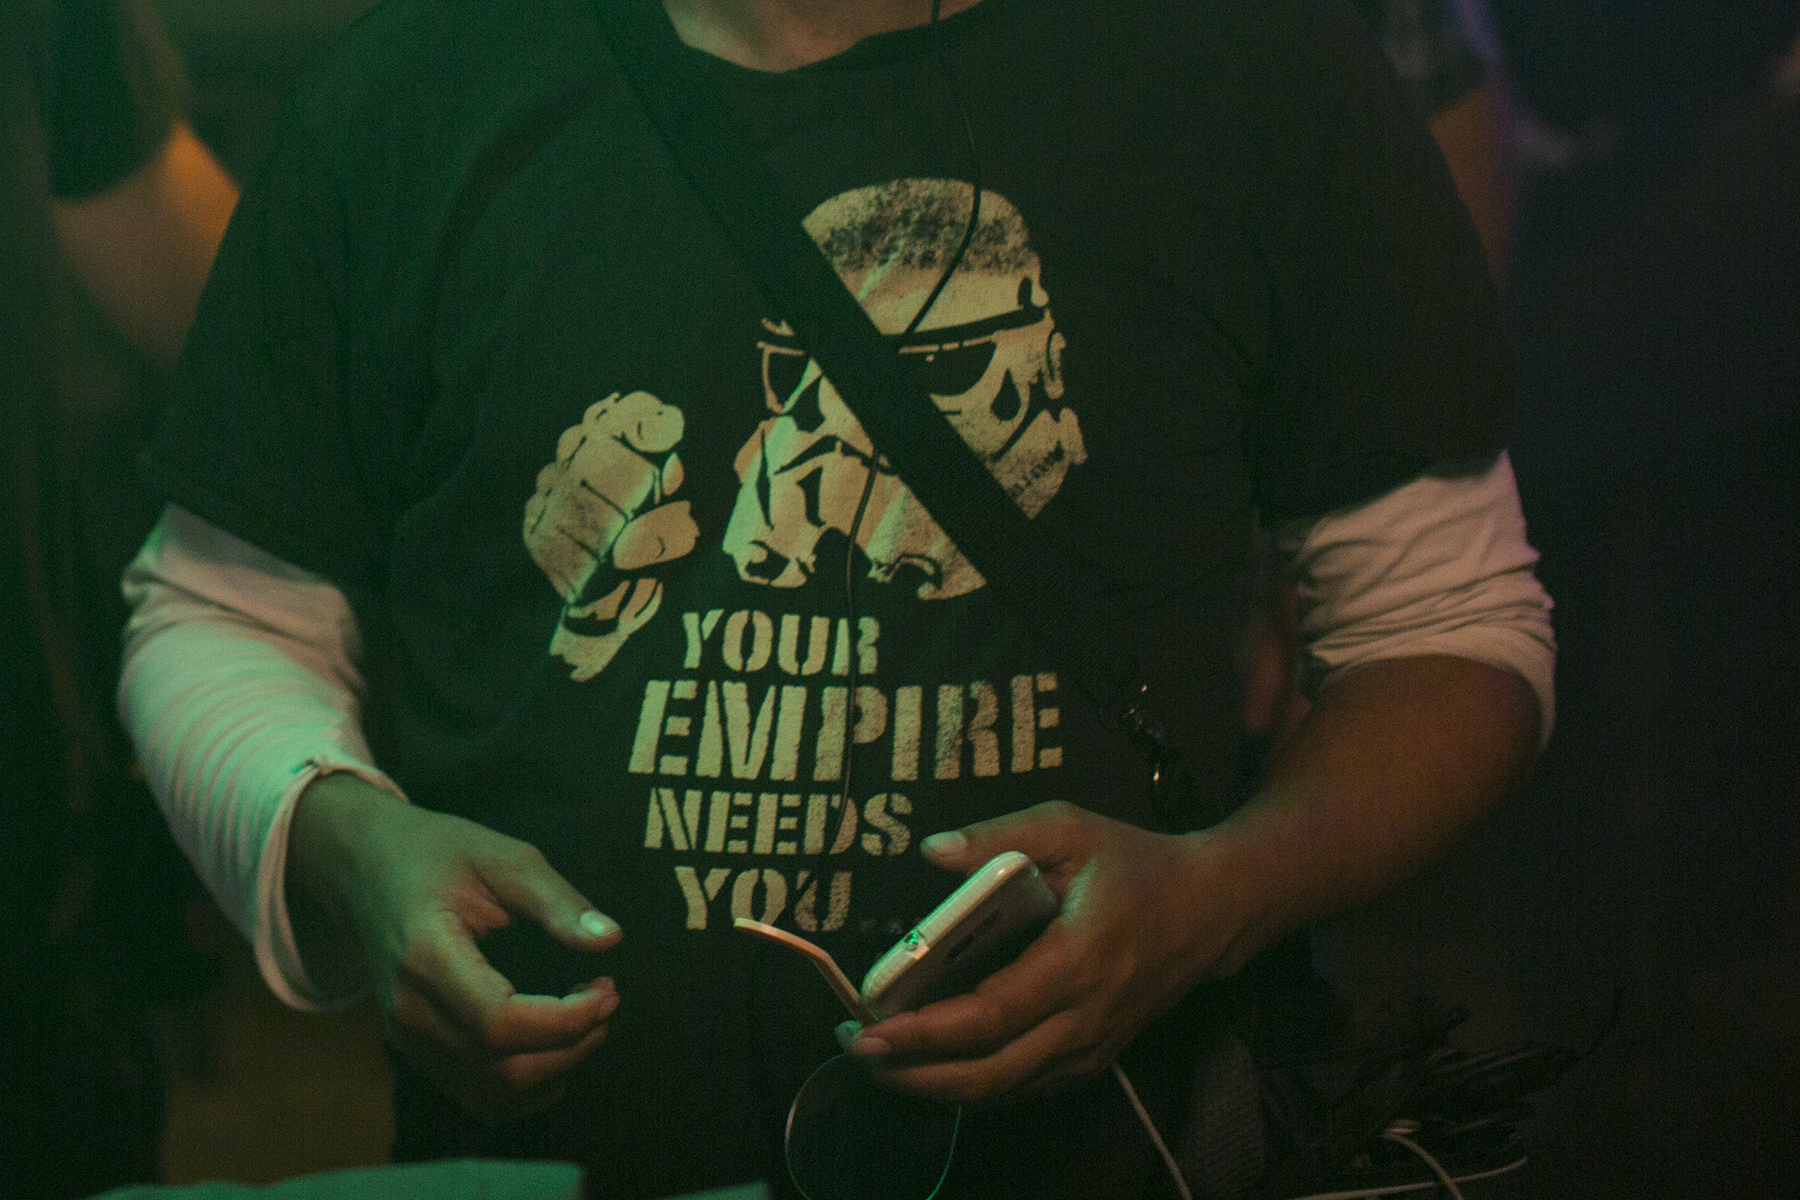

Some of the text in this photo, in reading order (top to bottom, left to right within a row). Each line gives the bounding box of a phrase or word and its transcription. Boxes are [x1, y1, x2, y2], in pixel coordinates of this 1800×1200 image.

[683, 609, 880, 675] YOUR
[629, 673, 1064, 782] EMPIRE
[645, 789, 913, 856] NEEDS
